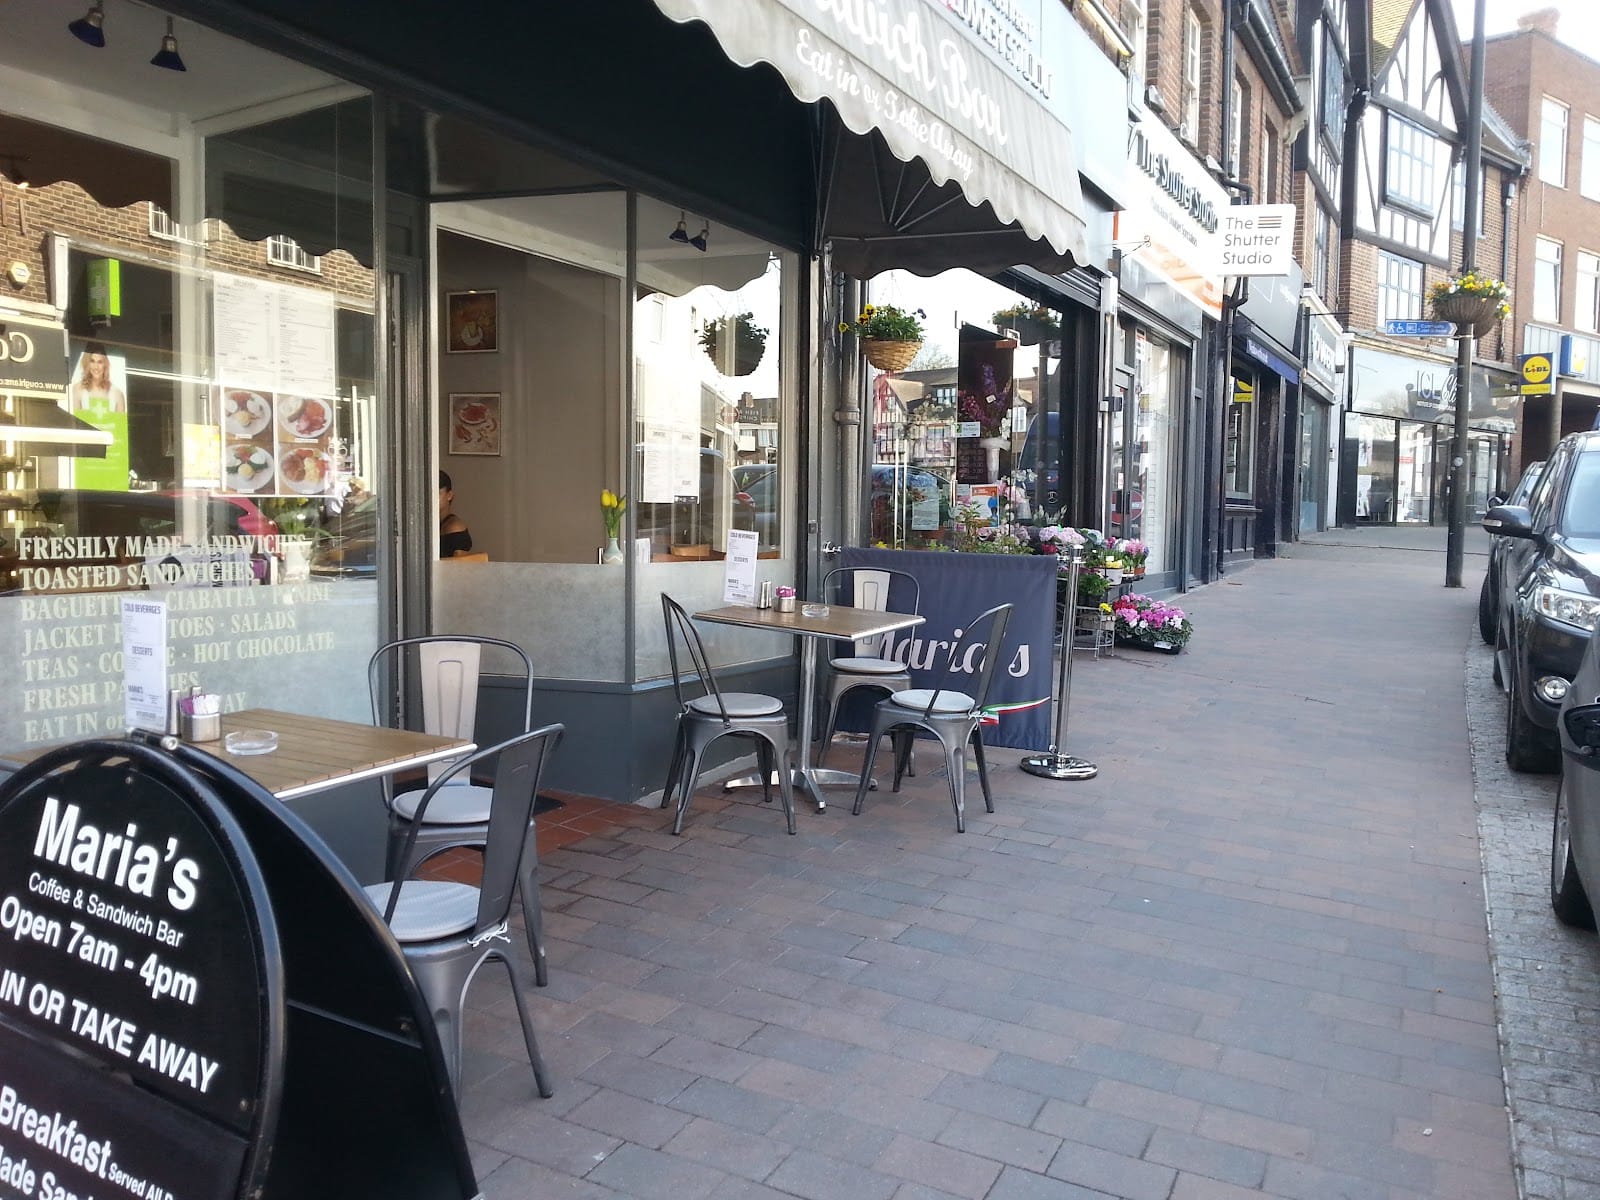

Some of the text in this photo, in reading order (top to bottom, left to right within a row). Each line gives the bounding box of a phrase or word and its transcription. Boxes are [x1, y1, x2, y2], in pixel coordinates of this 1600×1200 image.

[796, 28, 974, 182] Eat in or Take Away
[939, 38, 1008, 145] Bar
[1224, 233, 1280, 247] Shutter
[1225, 216, 1254, 230] The
[1222, 251, 1273, 265] Studio
[18, 535, 120, 561] FRESHLY
[125, 534, 183, 557] MADE
[19, 565, 121, 591] TOASTED
[129, 560, 255, 586] SANDWICHES
[21, 592, 146, 621] BAGUETT
[165, 588, 257, 611] CIABATTA
[22, 624, 107, 657] JACKET
[231, 610, 296, 633] SALADS
[22, 656, 79, 682] TEAS
[193, 641, 232, 664] HOT
[237, 632, 335, 659] CHOCOLATE
[23, 682, 97, 712] FRESH
[24, 715, 69, 742] EAT
[76, 711, 98, 735] IN
[33, 796, 200, 911] Maria's
[28, 871, 184, 949] Coffee & Sandwich Bar
[0, 896, 63, 947] Open
[67, 921, 119, 972] 7am
[139, 953, 199, 1006] 4pm
[0, 969, 219, 1094] IN OR TAKE AWAY
[0, 1085, 111, 1180] Breakfast
[108, 1162, 147, 1196] Served
[0, 1145, 36, 1195] ade
